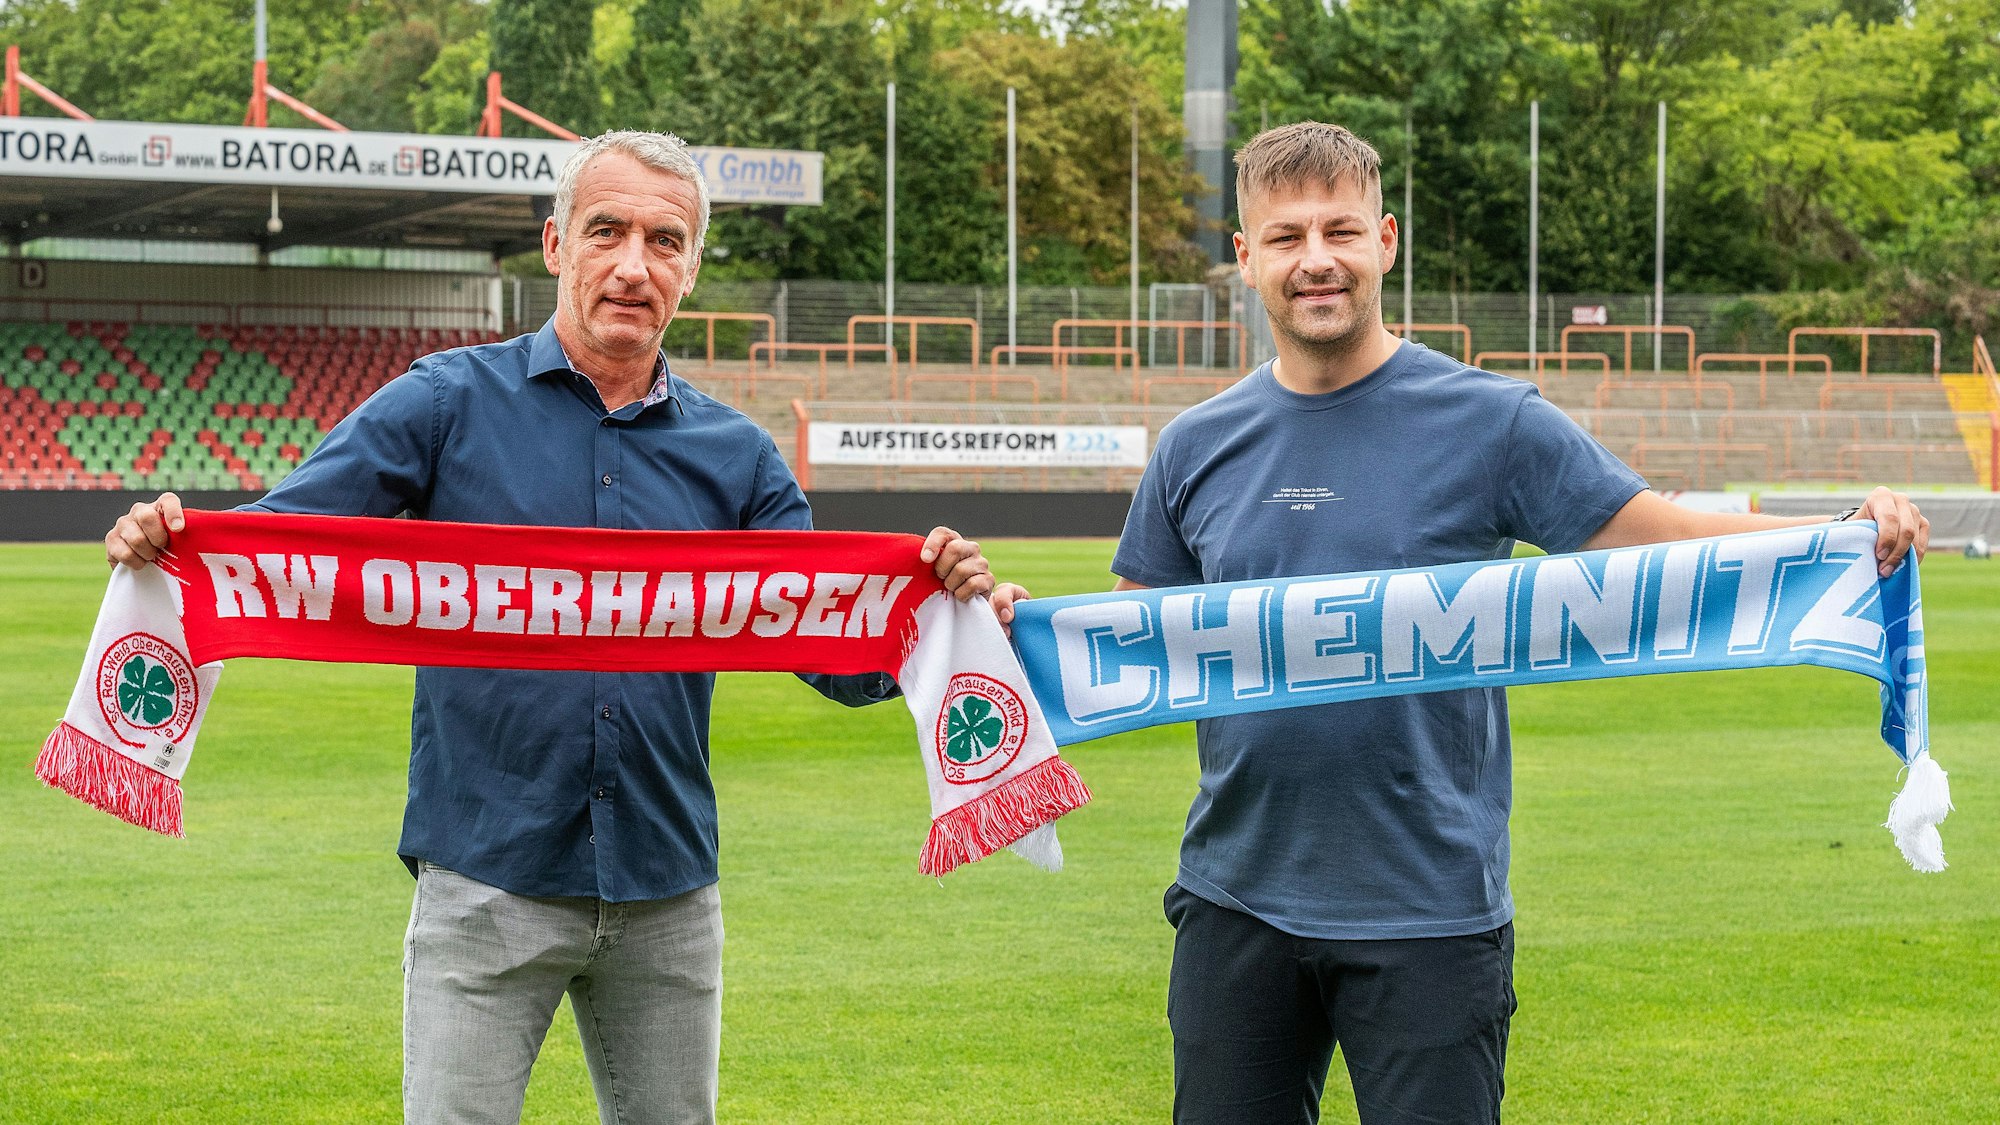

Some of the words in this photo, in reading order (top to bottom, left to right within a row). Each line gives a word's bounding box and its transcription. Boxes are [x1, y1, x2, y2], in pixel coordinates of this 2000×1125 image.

[222, 140, 361, 173] BATORA
[422, 148, 555, 180] BATORA
[718, 153, 803, 184] Gmbh
[839, 430, 1057, 450] AUFSTIEGSREFORM
[1301, 503, 1316, 511] 1966
[199, 553, 338, 619] RW
[361, 558, 914, 639] OBERHAUSEN
[1050, 528, 1886, 727] CHEMNITZ
[106, 703, 120, 724] SC
[947, 766, 966, 780] SC
